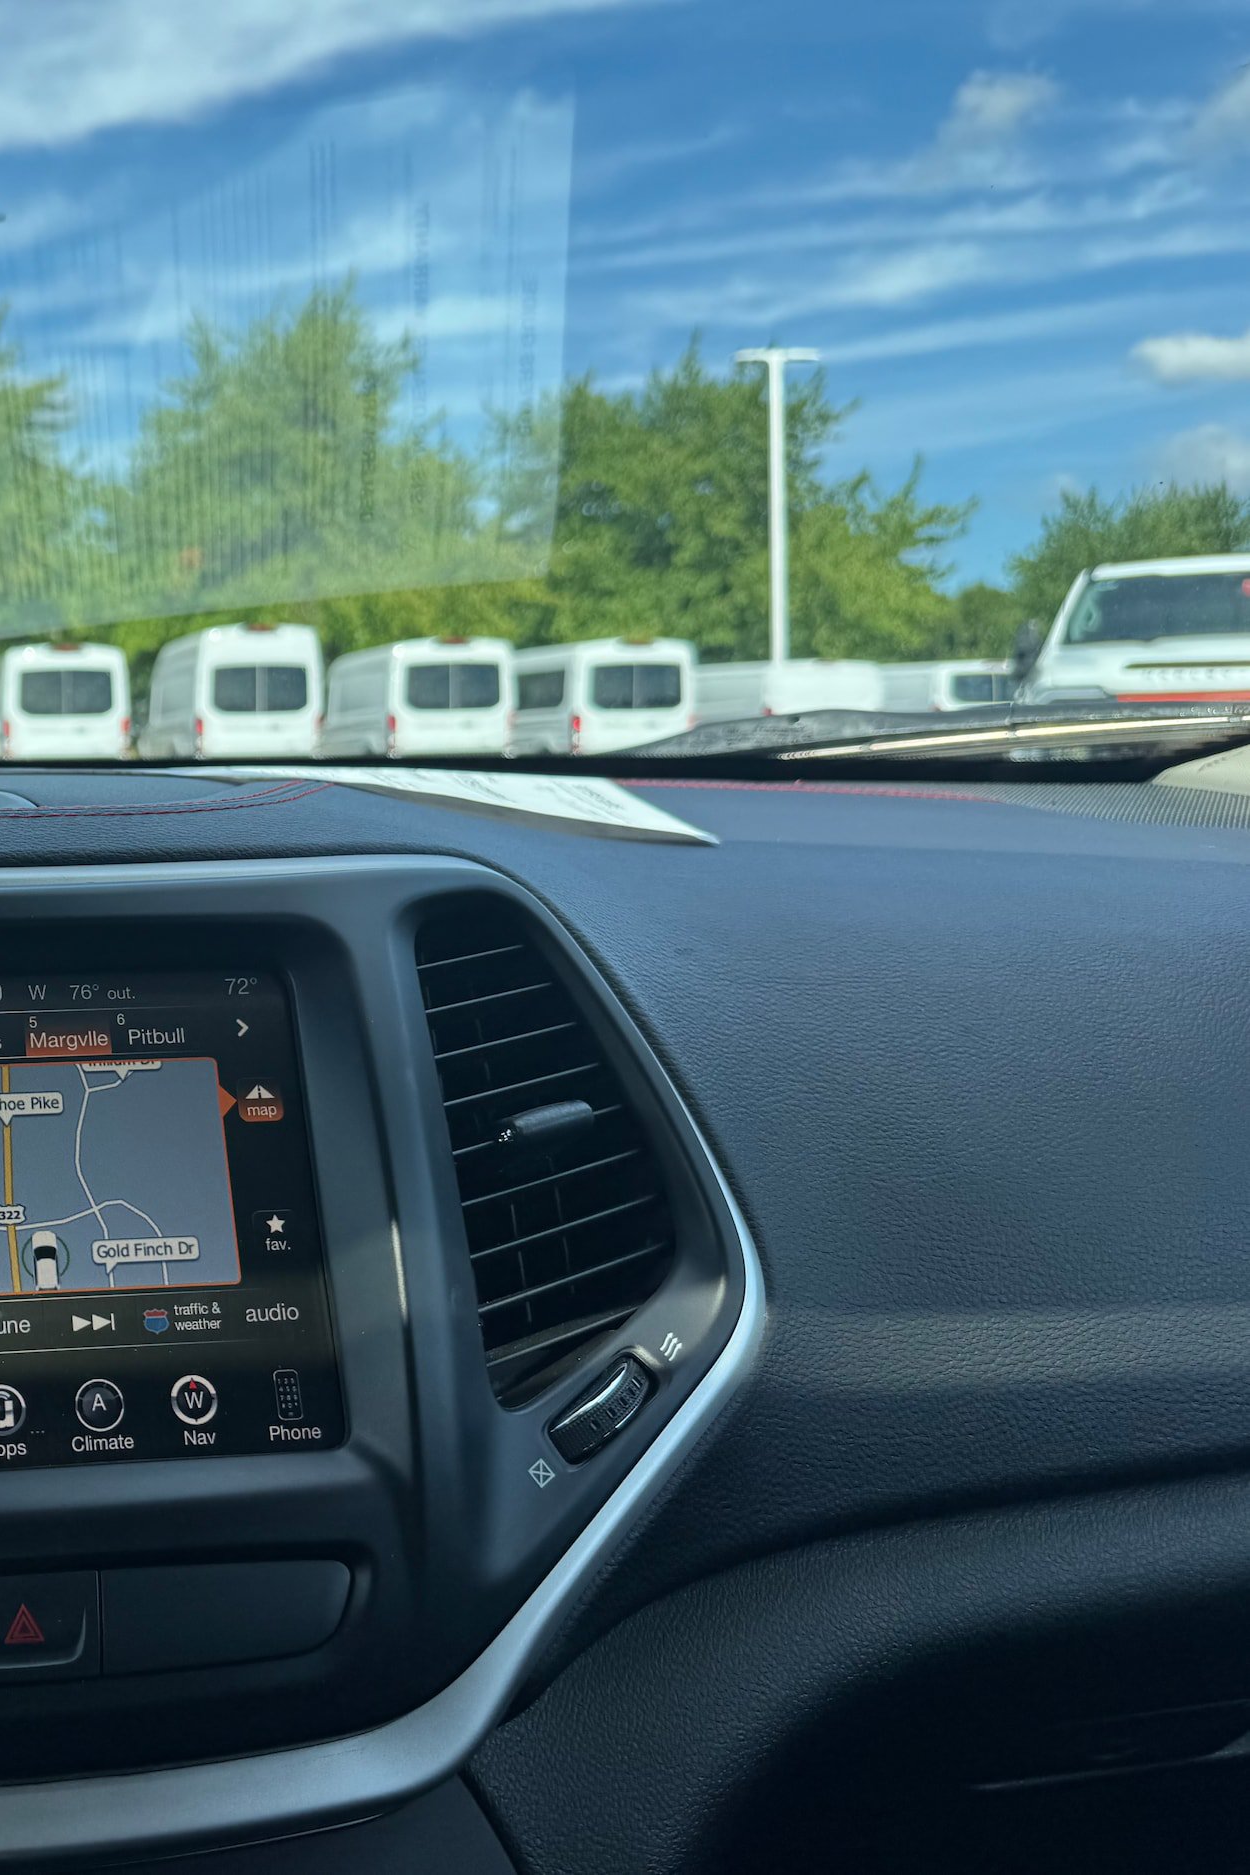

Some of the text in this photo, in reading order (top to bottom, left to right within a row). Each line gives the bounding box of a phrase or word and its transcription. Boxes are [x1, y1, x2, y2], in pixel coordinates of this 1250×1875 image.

[27, 984, 47, 1001] W
[69, 983, 136, 1001] 76° out.
[224, 977, 257, 996] 72°
[29, 1015, 38, 1029] 5
[116, 1013, 126, 1026] 6
[29, 1030, 109, 1052] Margvlle
[128, 1027, 185, 1045] Pitbull
[30, 1096, 60, 1110] Pike
[246, 1105, 278, 1119] map
[96, 1240, 195, 1258] Gold Finch Dr
[265, 1237, 291, 1251] fav.
[173, 1301, 222, 1316] traffic &
[245, 1302, 300, 1323] audio
[174, 1317, 222, 1331] weather
[92, 1393, 107, 1412] A
[184, 1390, 204, 1410] W
[183, 1429, 216, 1446] Nav
[268, 1424, 322, 1442] Phone
[71, 1434, 135, 1452] Climate
